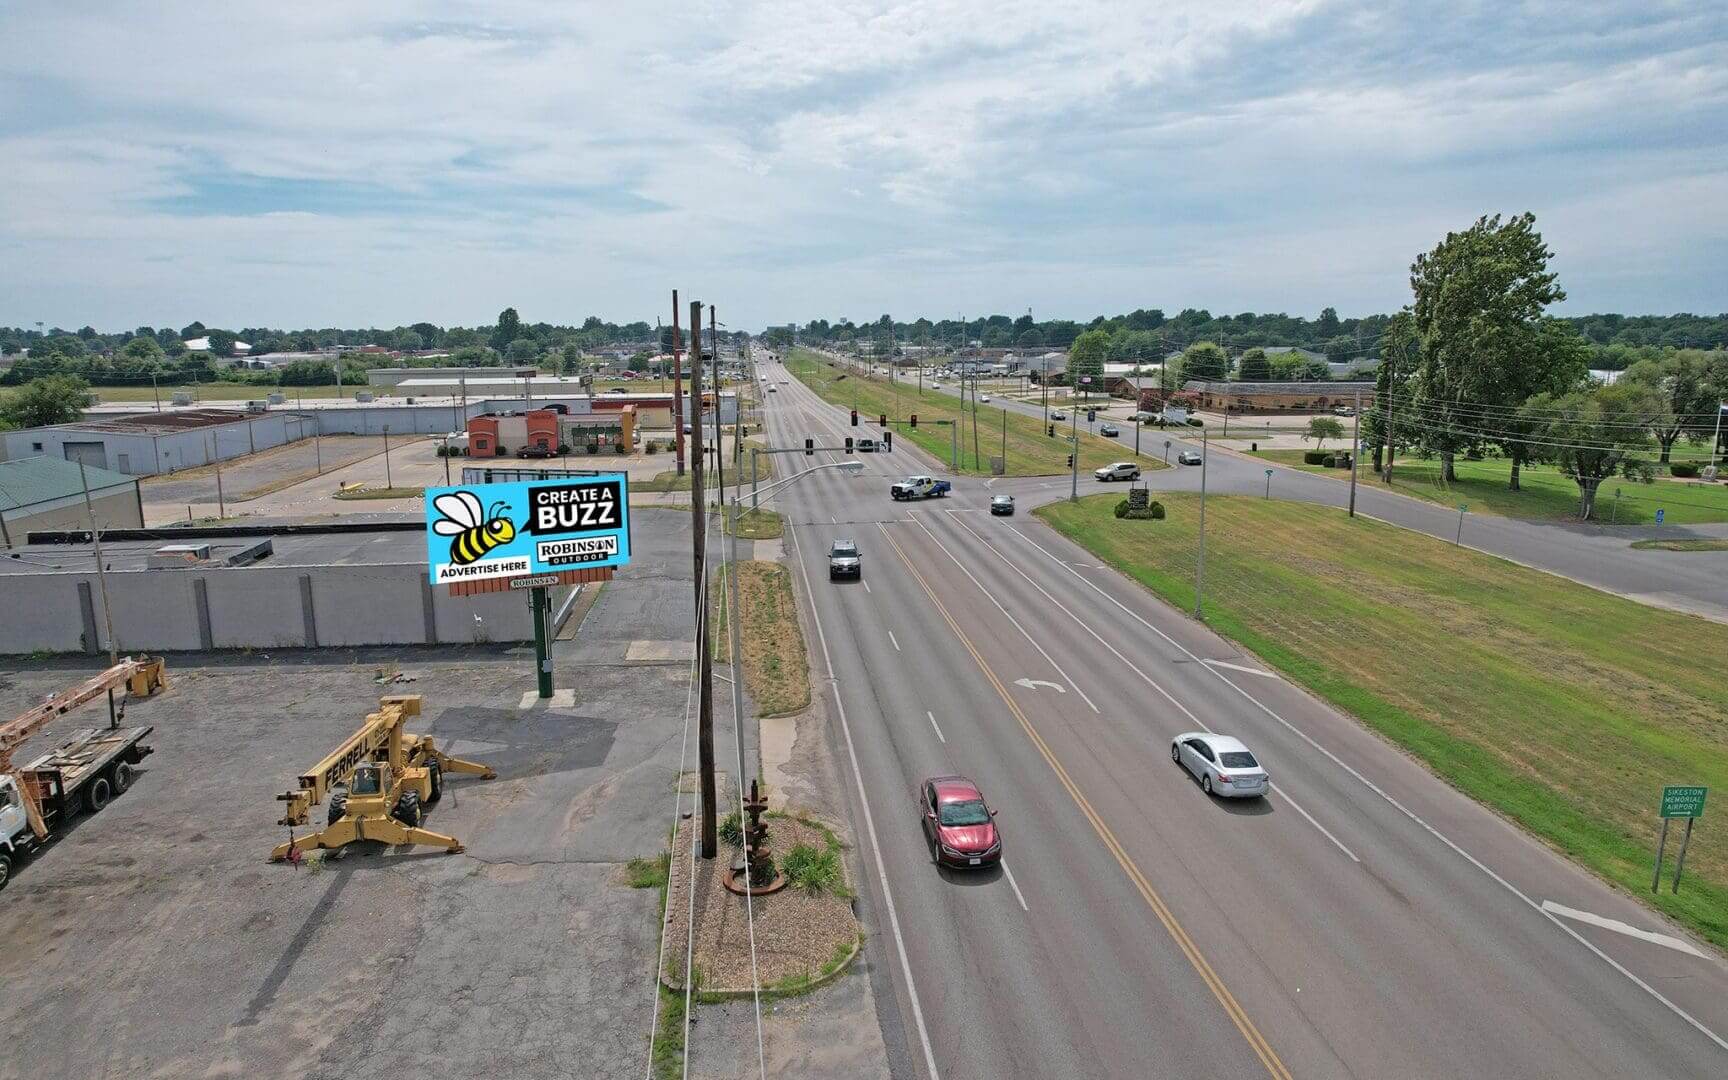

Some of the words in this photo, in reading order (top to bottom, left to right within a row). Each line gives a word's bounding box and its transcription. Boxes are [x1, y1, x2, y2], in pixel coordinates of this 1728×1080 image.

[537, 488, 598, 503] CREATE
[602, 487, 613, 499] A
[538, 502, 614, 529] BUZZ
[541, 539, 614, 556] ROBINSON
[553, 553, 604, 564] OUTDOOR
[440, 565, 499, 578] ADVERTISE
[501, 561, 527, 574] HERE
[325, 737, 370, 789] FERRELL
